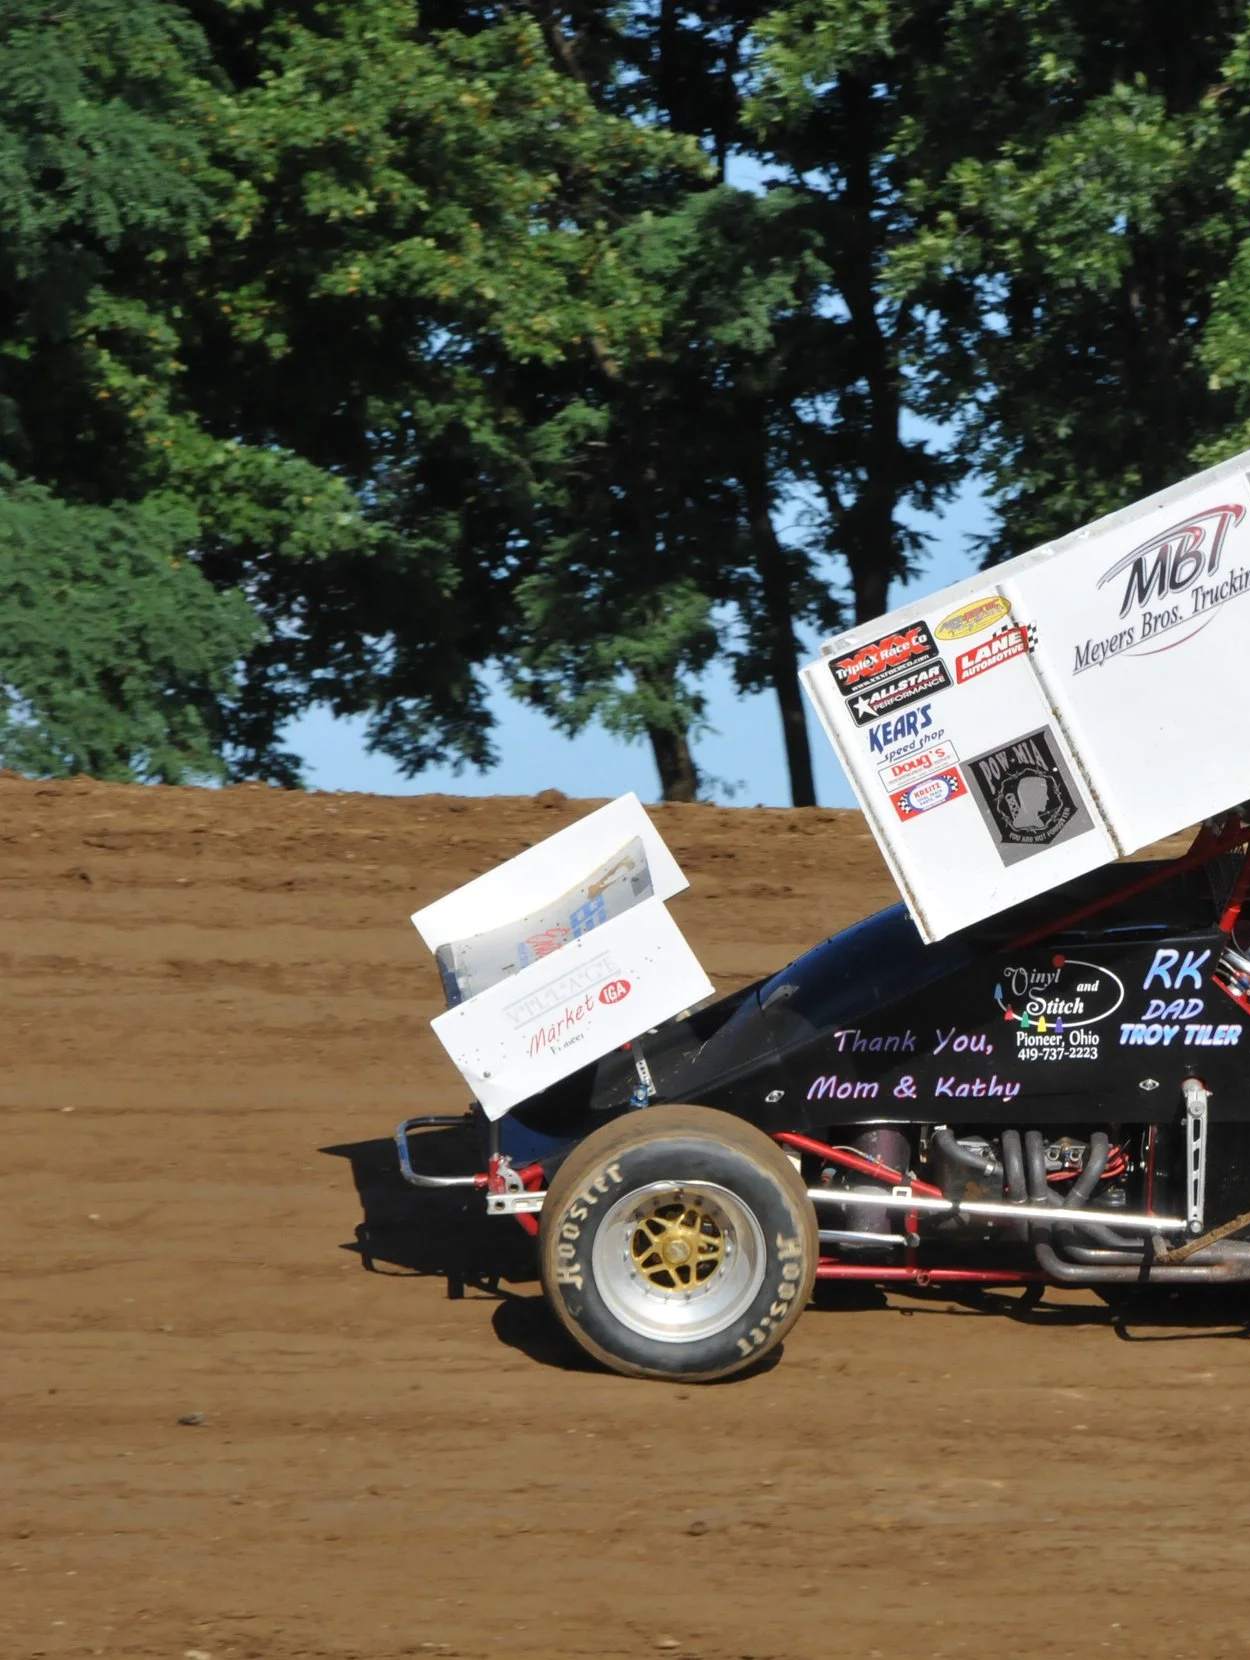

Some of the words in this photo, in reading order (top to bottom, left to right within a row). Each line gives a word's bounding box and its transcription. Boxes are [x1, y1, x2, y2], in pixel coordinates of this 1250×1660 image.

[1119, 504, 1246, 619] MBT
[880, 641, 911, 661] Race
[911, 633, 928, 647] Co
[960, 631, 1023, 670] LANE
[1073, 625, 1135, 667] Meyers
[1140, 604, 1184, 640] Bros.
[961, 643, 1025, 680] AUTOMOTIVE
[869, 665, 941, 704] ALLSTAR
[873, 676, 946, 711] PERFORMANCE
[868, 703, 933, 755] KEAR'S
[891, 748, 946, 777] Doug's
[913, 782, 942, 798] KREITZ
[1003, 966, 1062, 996] Vinyl
[1142, 948, 1212, 991] RK
[1026, 986, 1085, 1016] Stitch
[1076, 979, 1101, 993] and
[529, 993, 597, 1058] Market
[603, 981, 627, 1004] IGA
[1140, 998, 1205, 1021] DAD
[834, 1028, 918, 1053] Thank
[932, 1026, 994, 1055] You,
[1016, 1029, 1066, 1048] Pioneer,
[1069, 1029, 1100, 1046] Ohio
[1119, 1023, 1180, 1046] TROY
[1183, 1023, 1243, 1046] TILER
[1017, 1047, 1099, 1061] 419-737-2223
[805, 1074, 880, 1101] Mom
[893, 1074, 918, 1099] &
[934, 1074, 1022, 1103] Kathy
